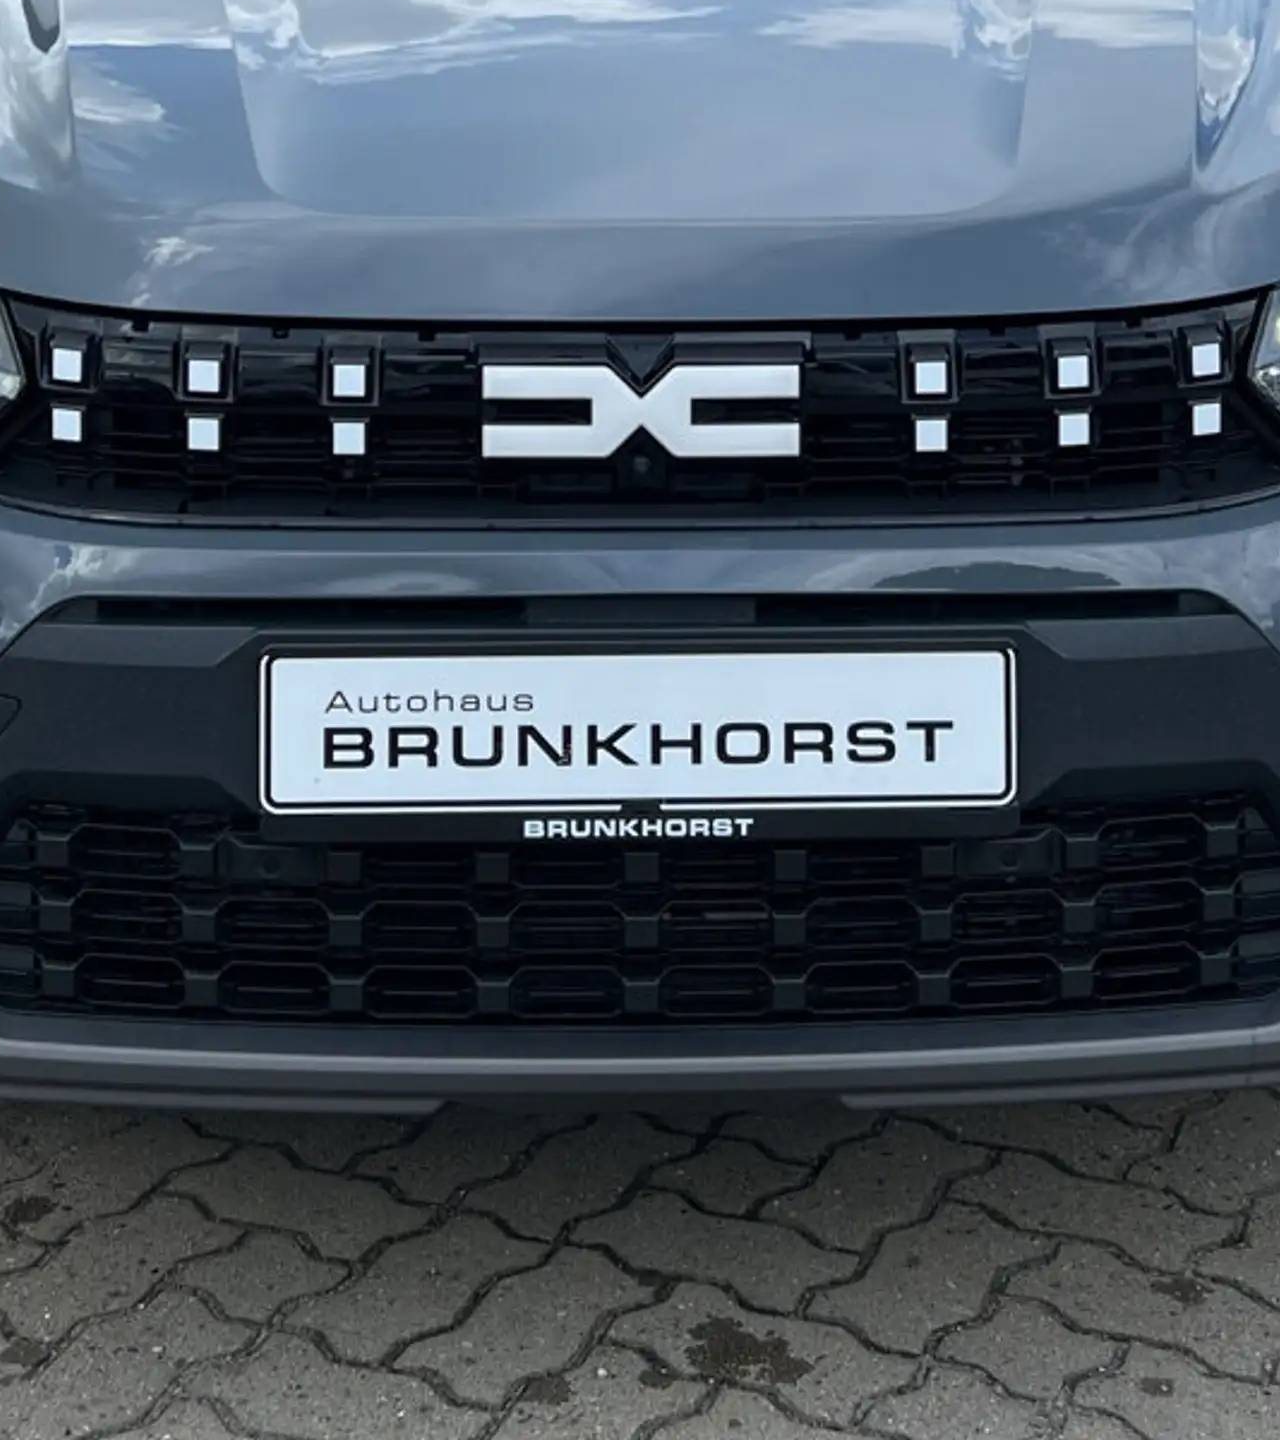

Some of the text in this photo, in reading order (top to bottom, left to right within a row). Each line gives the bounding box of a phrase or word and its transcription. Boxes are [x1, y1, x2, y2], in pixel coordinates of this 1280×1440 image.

[324, 690, 534, 714] Autohaus
[322, 720, 955, 770] BRUNKHORST
[522, 817, 756, 840] BRUNKHORST
